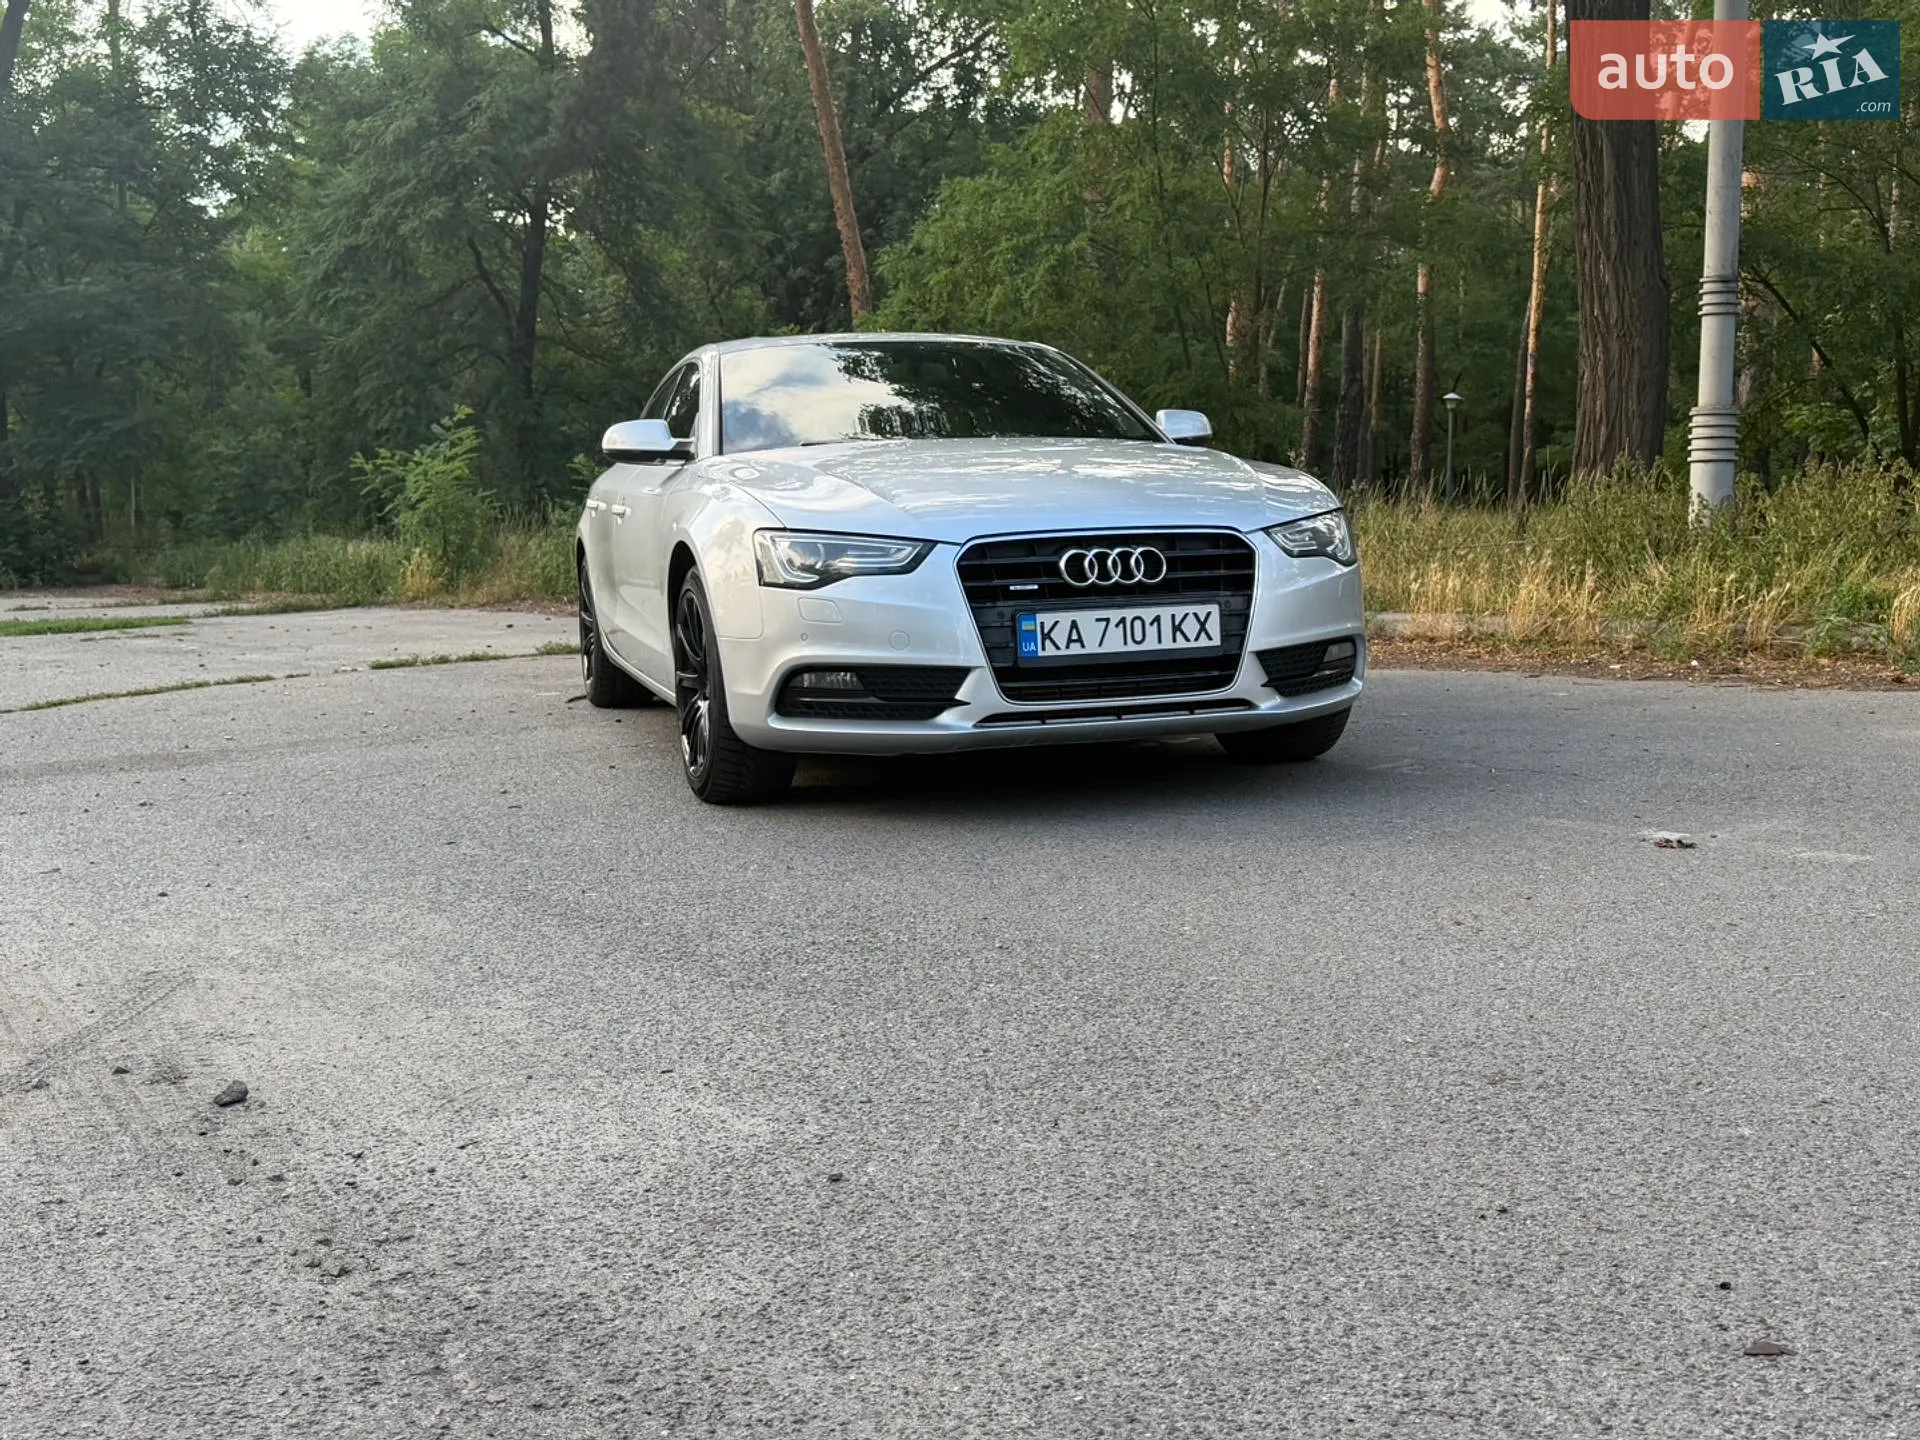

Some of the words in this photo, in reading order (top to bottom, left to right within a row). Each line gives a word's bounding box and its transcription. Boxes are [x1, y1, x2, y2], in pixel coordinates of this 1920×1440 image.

[1040, 619, 1086, 651] KA
[1095, 615, 1162, 647] 7101
[1171, 611, 1213, 643] KX
[1022, 642, 1037, 652] UA
